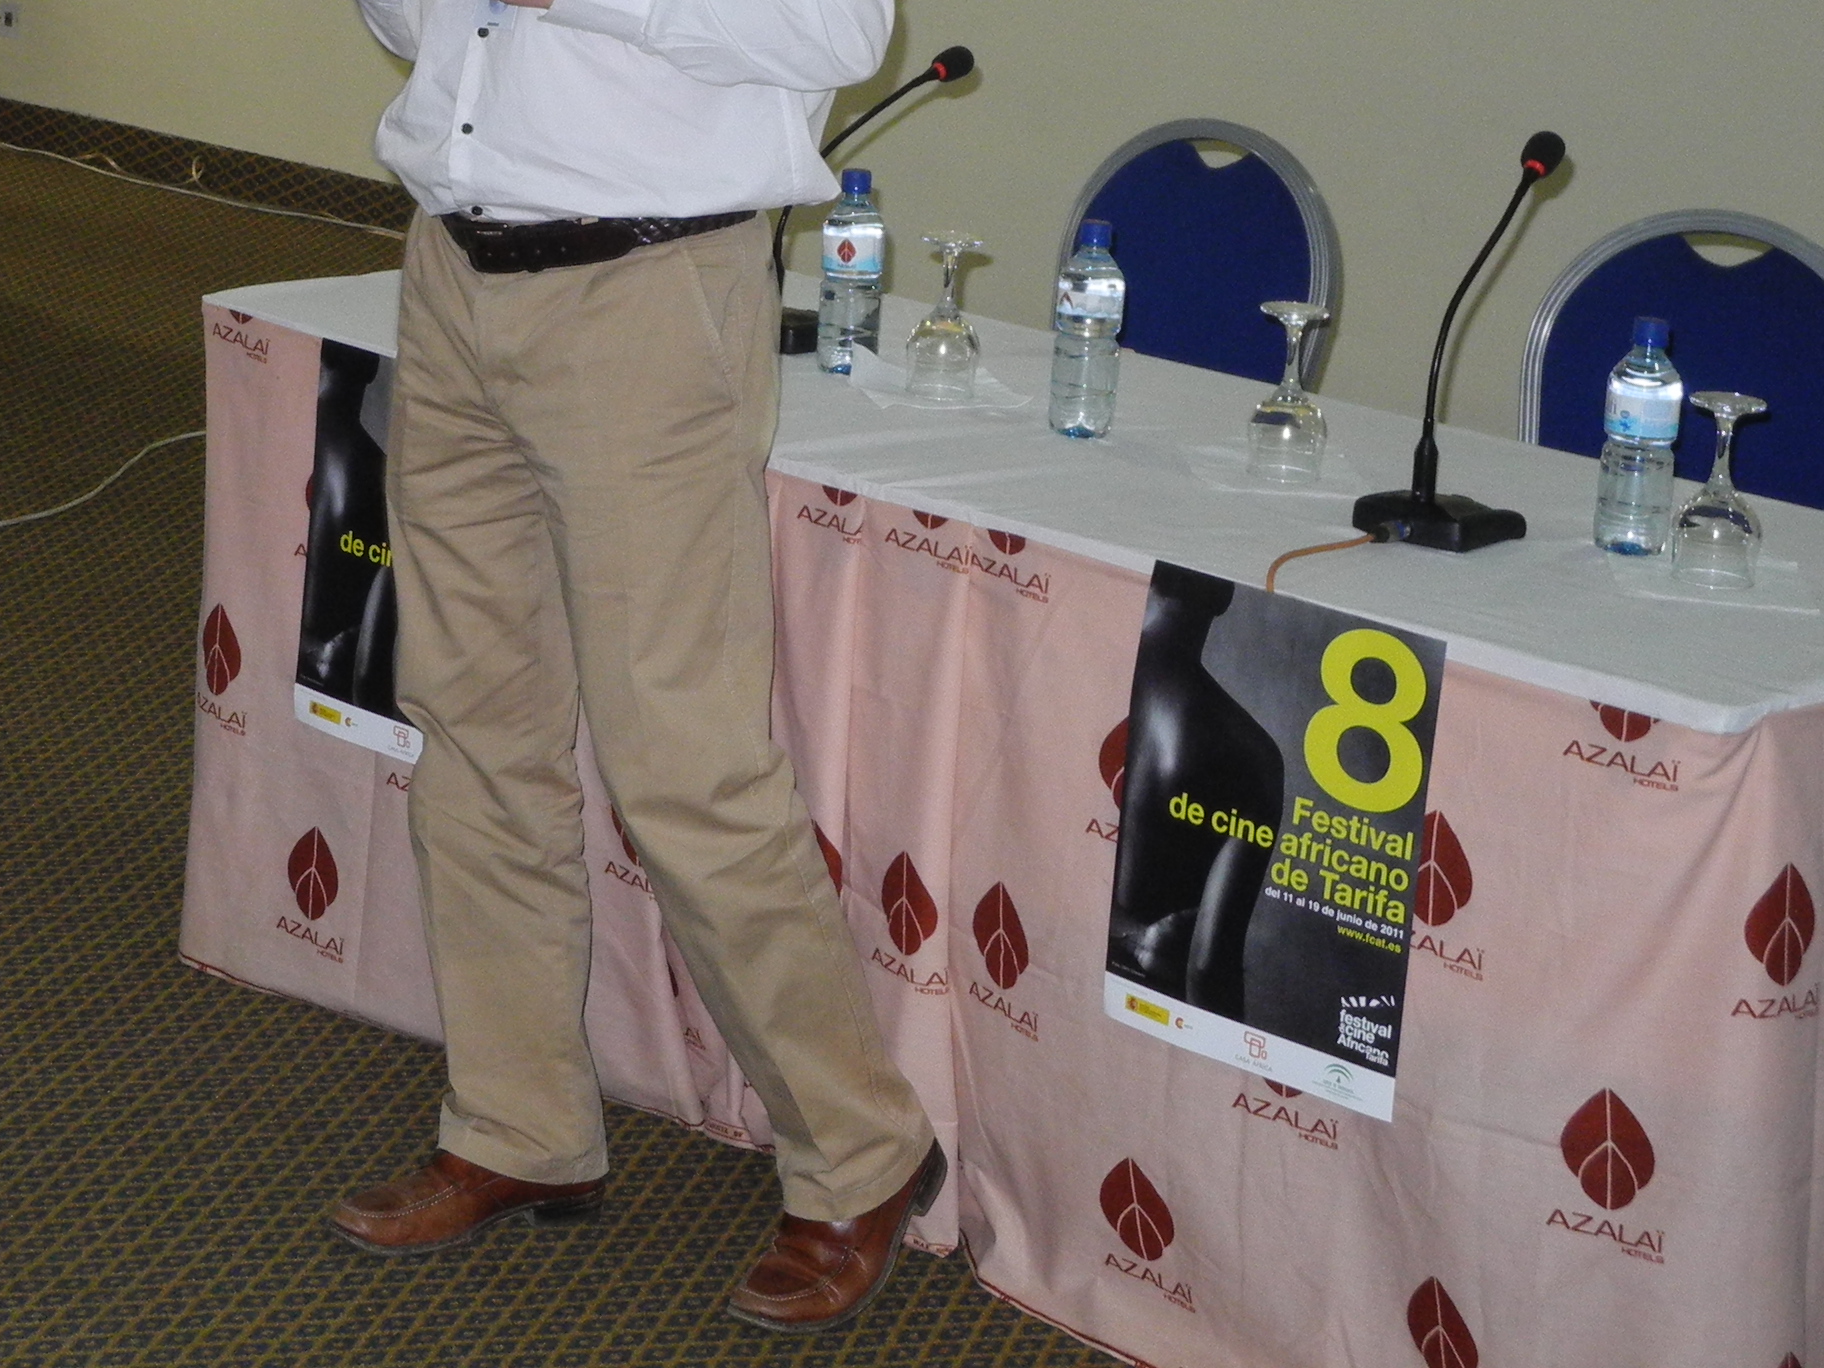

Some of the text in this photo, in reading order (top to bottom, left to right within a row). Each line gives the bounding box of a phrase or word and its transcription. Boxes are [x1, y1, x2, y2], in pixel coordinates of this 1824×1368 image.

[213, 322, 271, 355] AZALAÏ
[339, 530, 365, 558] de
[884, 527, 972, 567] AZALAÏ
[972, 553, 1052, 594] AZALAÏ
[1304, 628, 1427, 813] 8
[1562, 739, 1682, 783] AZALAÏ
[1632, 777, 1680, 793] HOTELS
[1168, 791, 1274, 848] de cine
[1291, 796, 1415, 861] Festival
[1279, 831, 1411, 892] africano
[1264, 886, 1404, 939] del 11 al 19 de junio de 2011
[1270, 858, 1407, 925] de Tarifa
[276, 915, 345, 957] AZALAÏ
[968, 981, 1040, 1032] AZALAÏ
[1340, 1008, 1393, 1039] festival
[1336, 1033, 1390, 1059] Africano
[1345, 1024, 1376, 1045] cine
[1365, 1052, 1390, 1066] Tarifa
[1231, 1092, 1340, 1140] AZALAÏ
[1545, 1208, 1666, 1254] AZALAÏ
[1620, 1246, 1666, 1265] HOTELS
[1104, 1252, 1194, 1303] AZALAÏ
